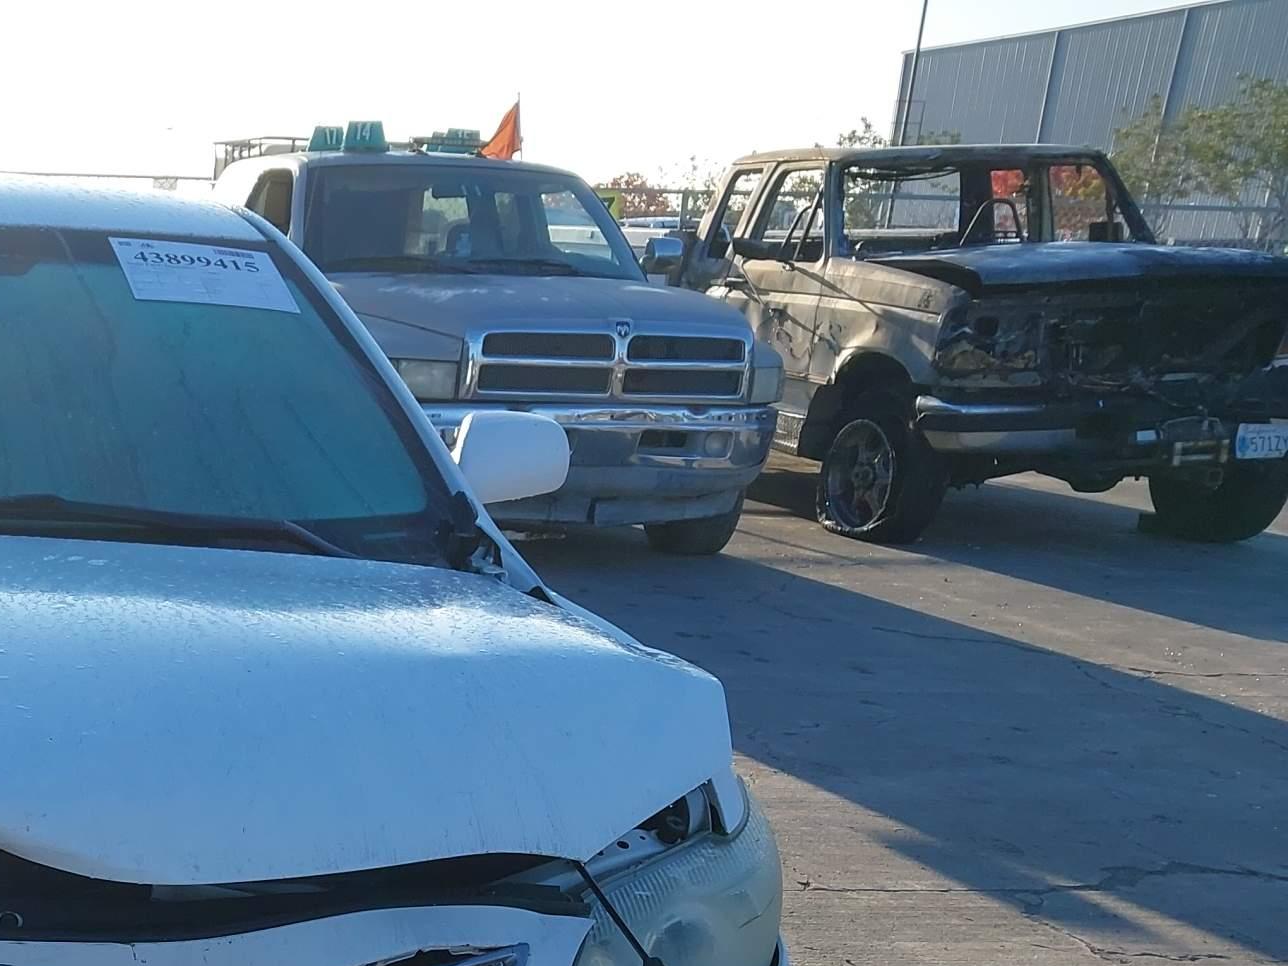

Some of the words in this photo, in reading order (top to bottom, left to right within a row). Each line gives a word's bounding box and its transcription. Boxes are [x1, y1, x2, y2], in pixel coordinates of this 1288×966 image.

[324, 127, 337, 145] 17
[355, 122, 371, 140] 14
[133, 250, 261, 273] 43899415
